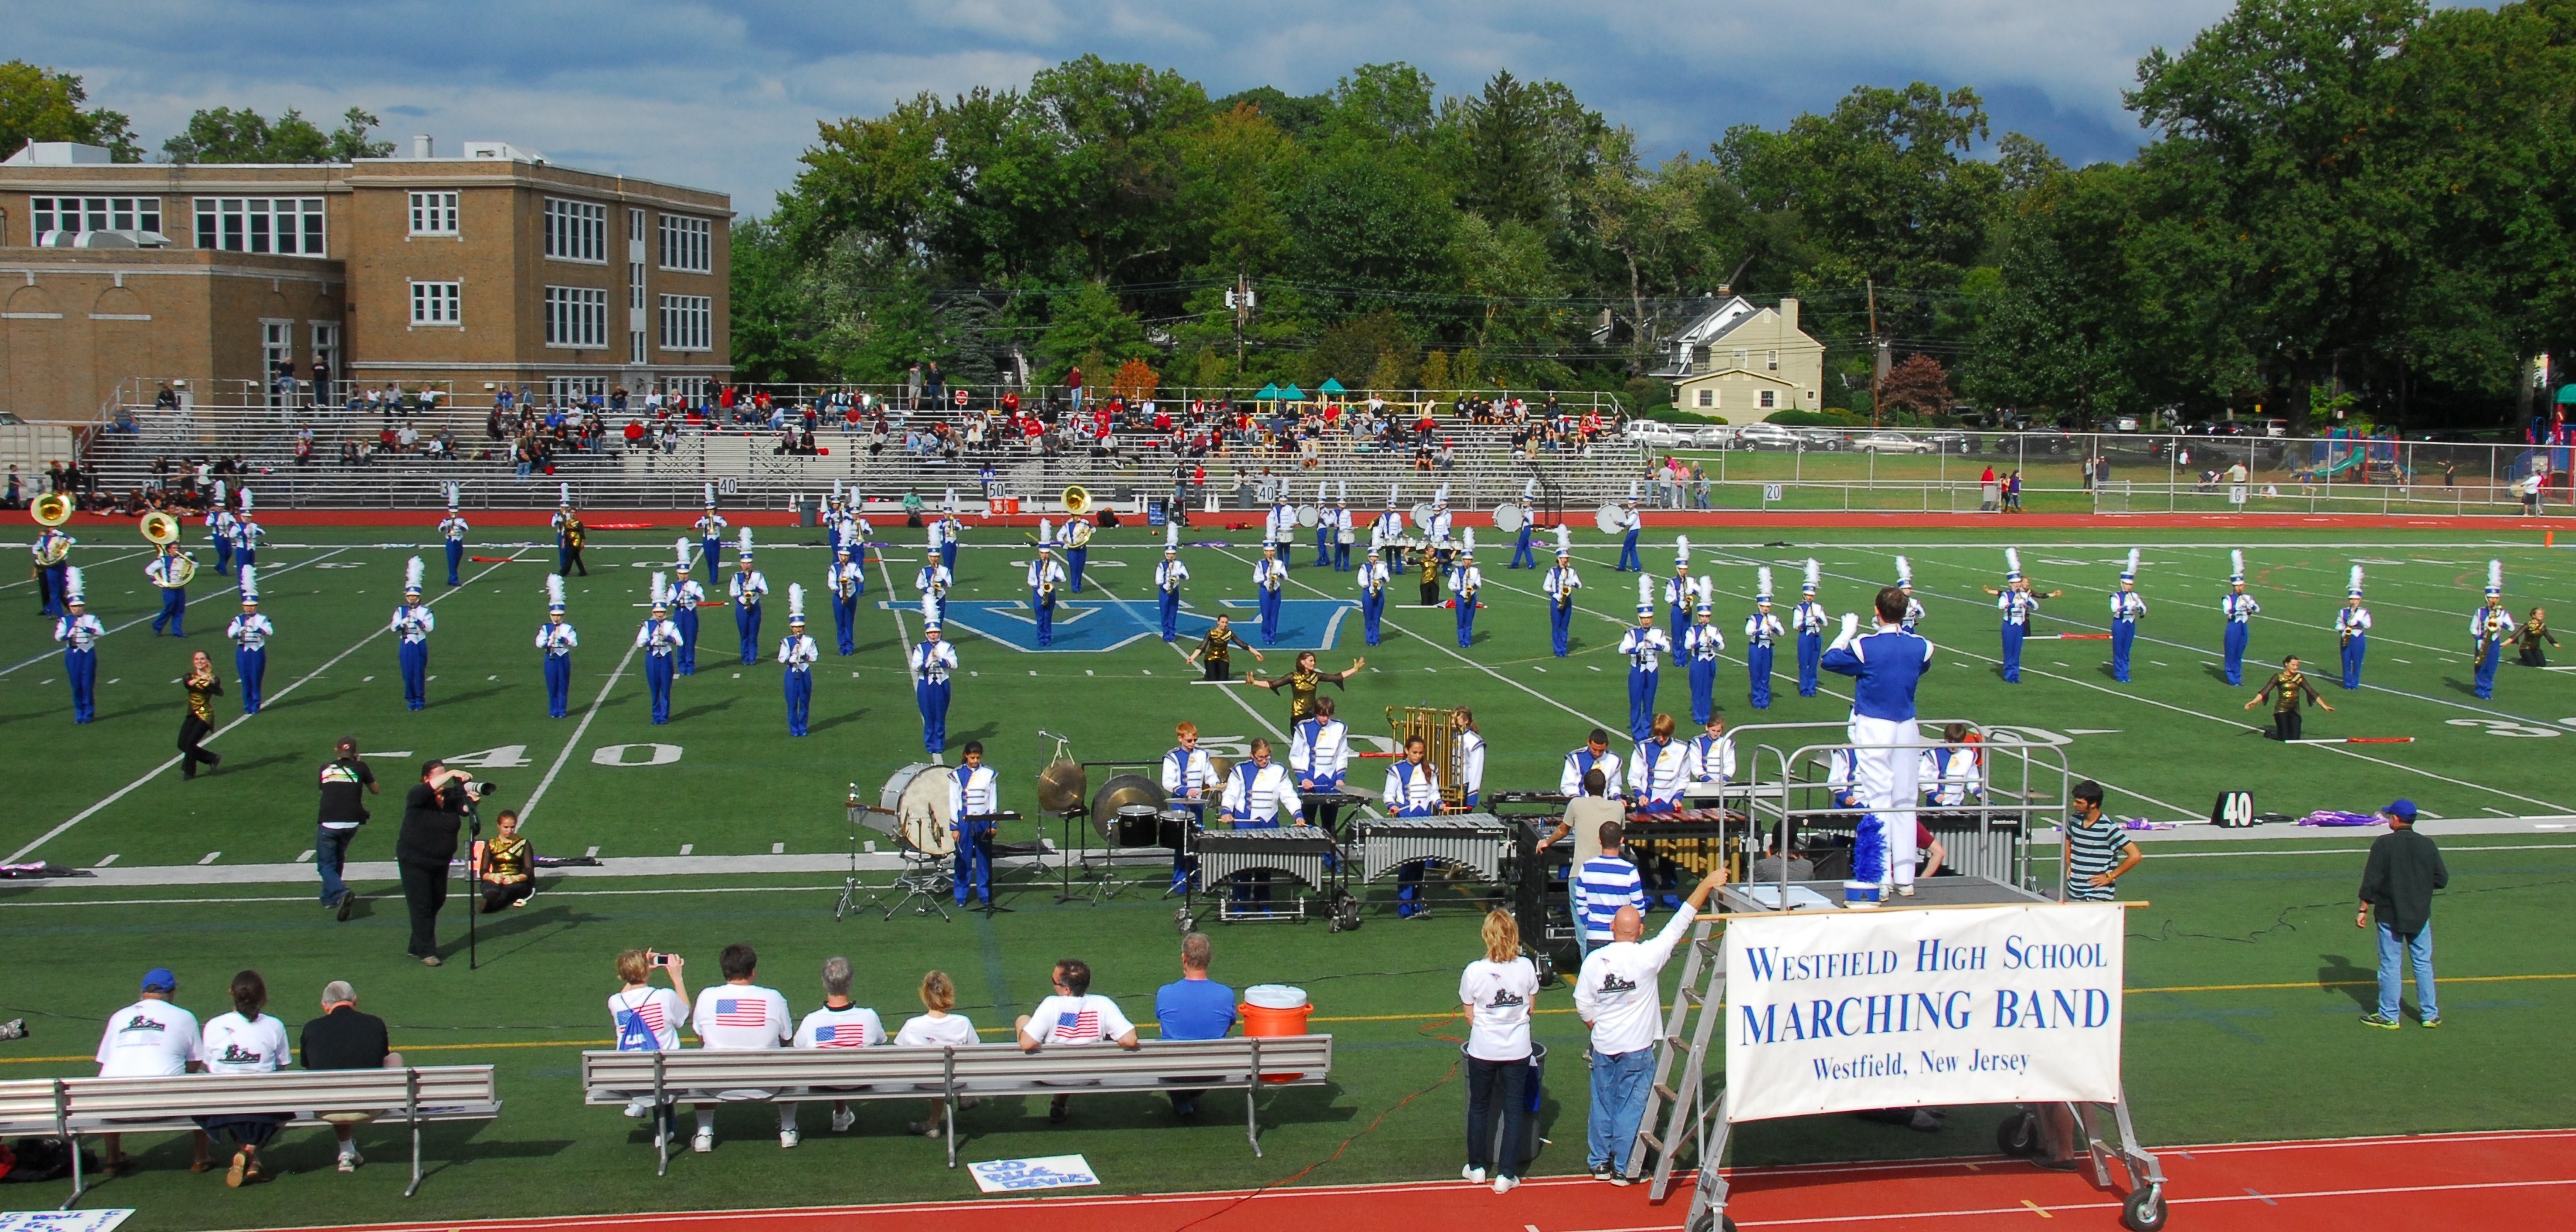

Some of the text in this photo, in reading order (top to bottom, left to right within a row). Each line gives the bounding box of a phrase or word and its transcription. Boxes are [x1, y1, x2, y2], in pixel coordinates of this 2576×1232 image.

[720, 479, 735, 493] 40
[989, 483, 1003, 497] 50
[1259, 486, 1273, 500] 40
[1767, 485, 1779, 499] 20
[2234, 488, 2241, 502] G
[2223, 792, 2252, 826] 40
[1745, 934, 2108, 983] WESTFIELD HIGH SCHOOL
[1739, 988, 2110, 1046] MARCHING BAND
[1813, 1048, 2031, 1081] Westfield, New Jersey
[977, 1161, 1027, 1172] GO
[1002, 1173, 1093, 1189] DEVILS
